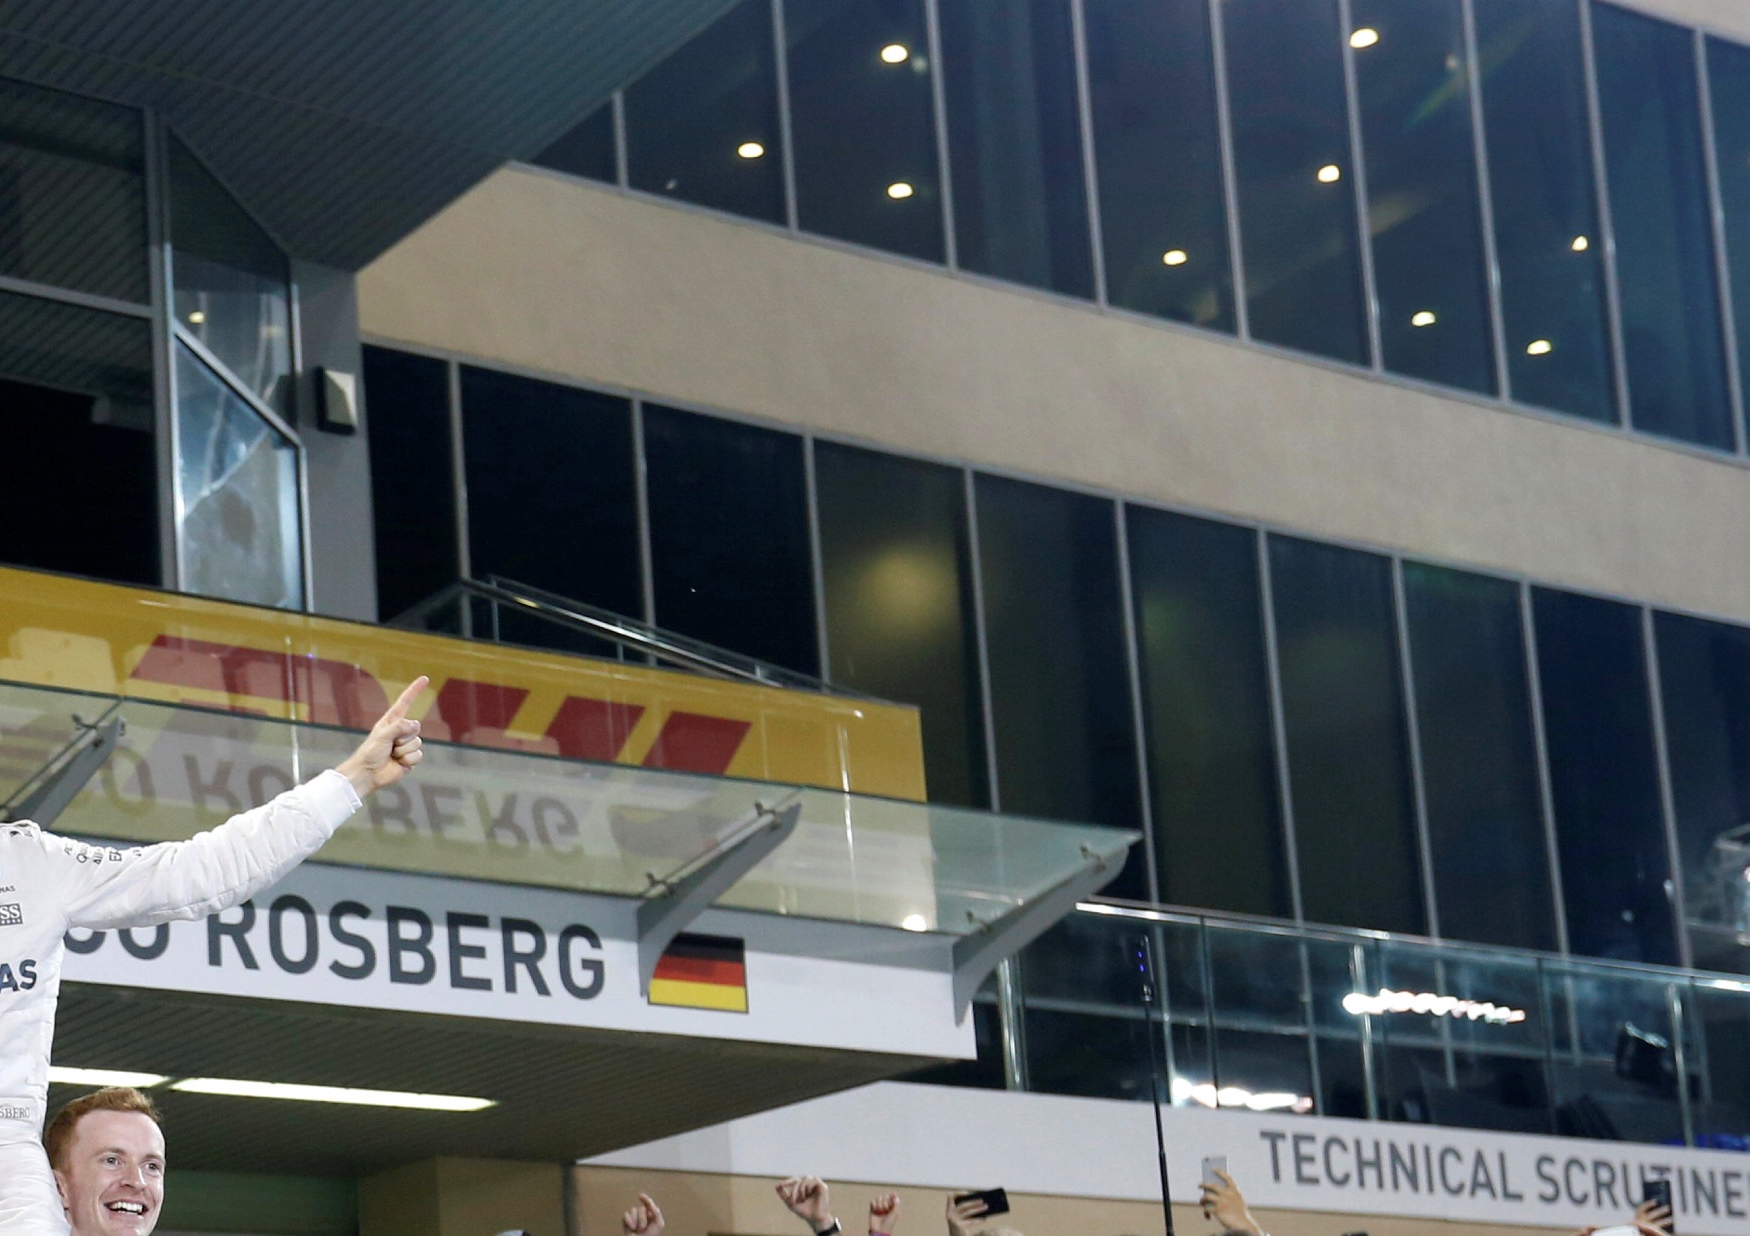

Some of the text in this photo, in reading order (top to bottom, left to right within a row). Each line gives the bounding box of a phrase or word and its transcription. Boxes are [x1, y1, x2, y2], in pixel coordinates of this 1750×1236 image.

[207, 893, 605, 1000] ROSBERG
[1260, 1129, 1749, 1219] TECHNICAL SCRUINE
